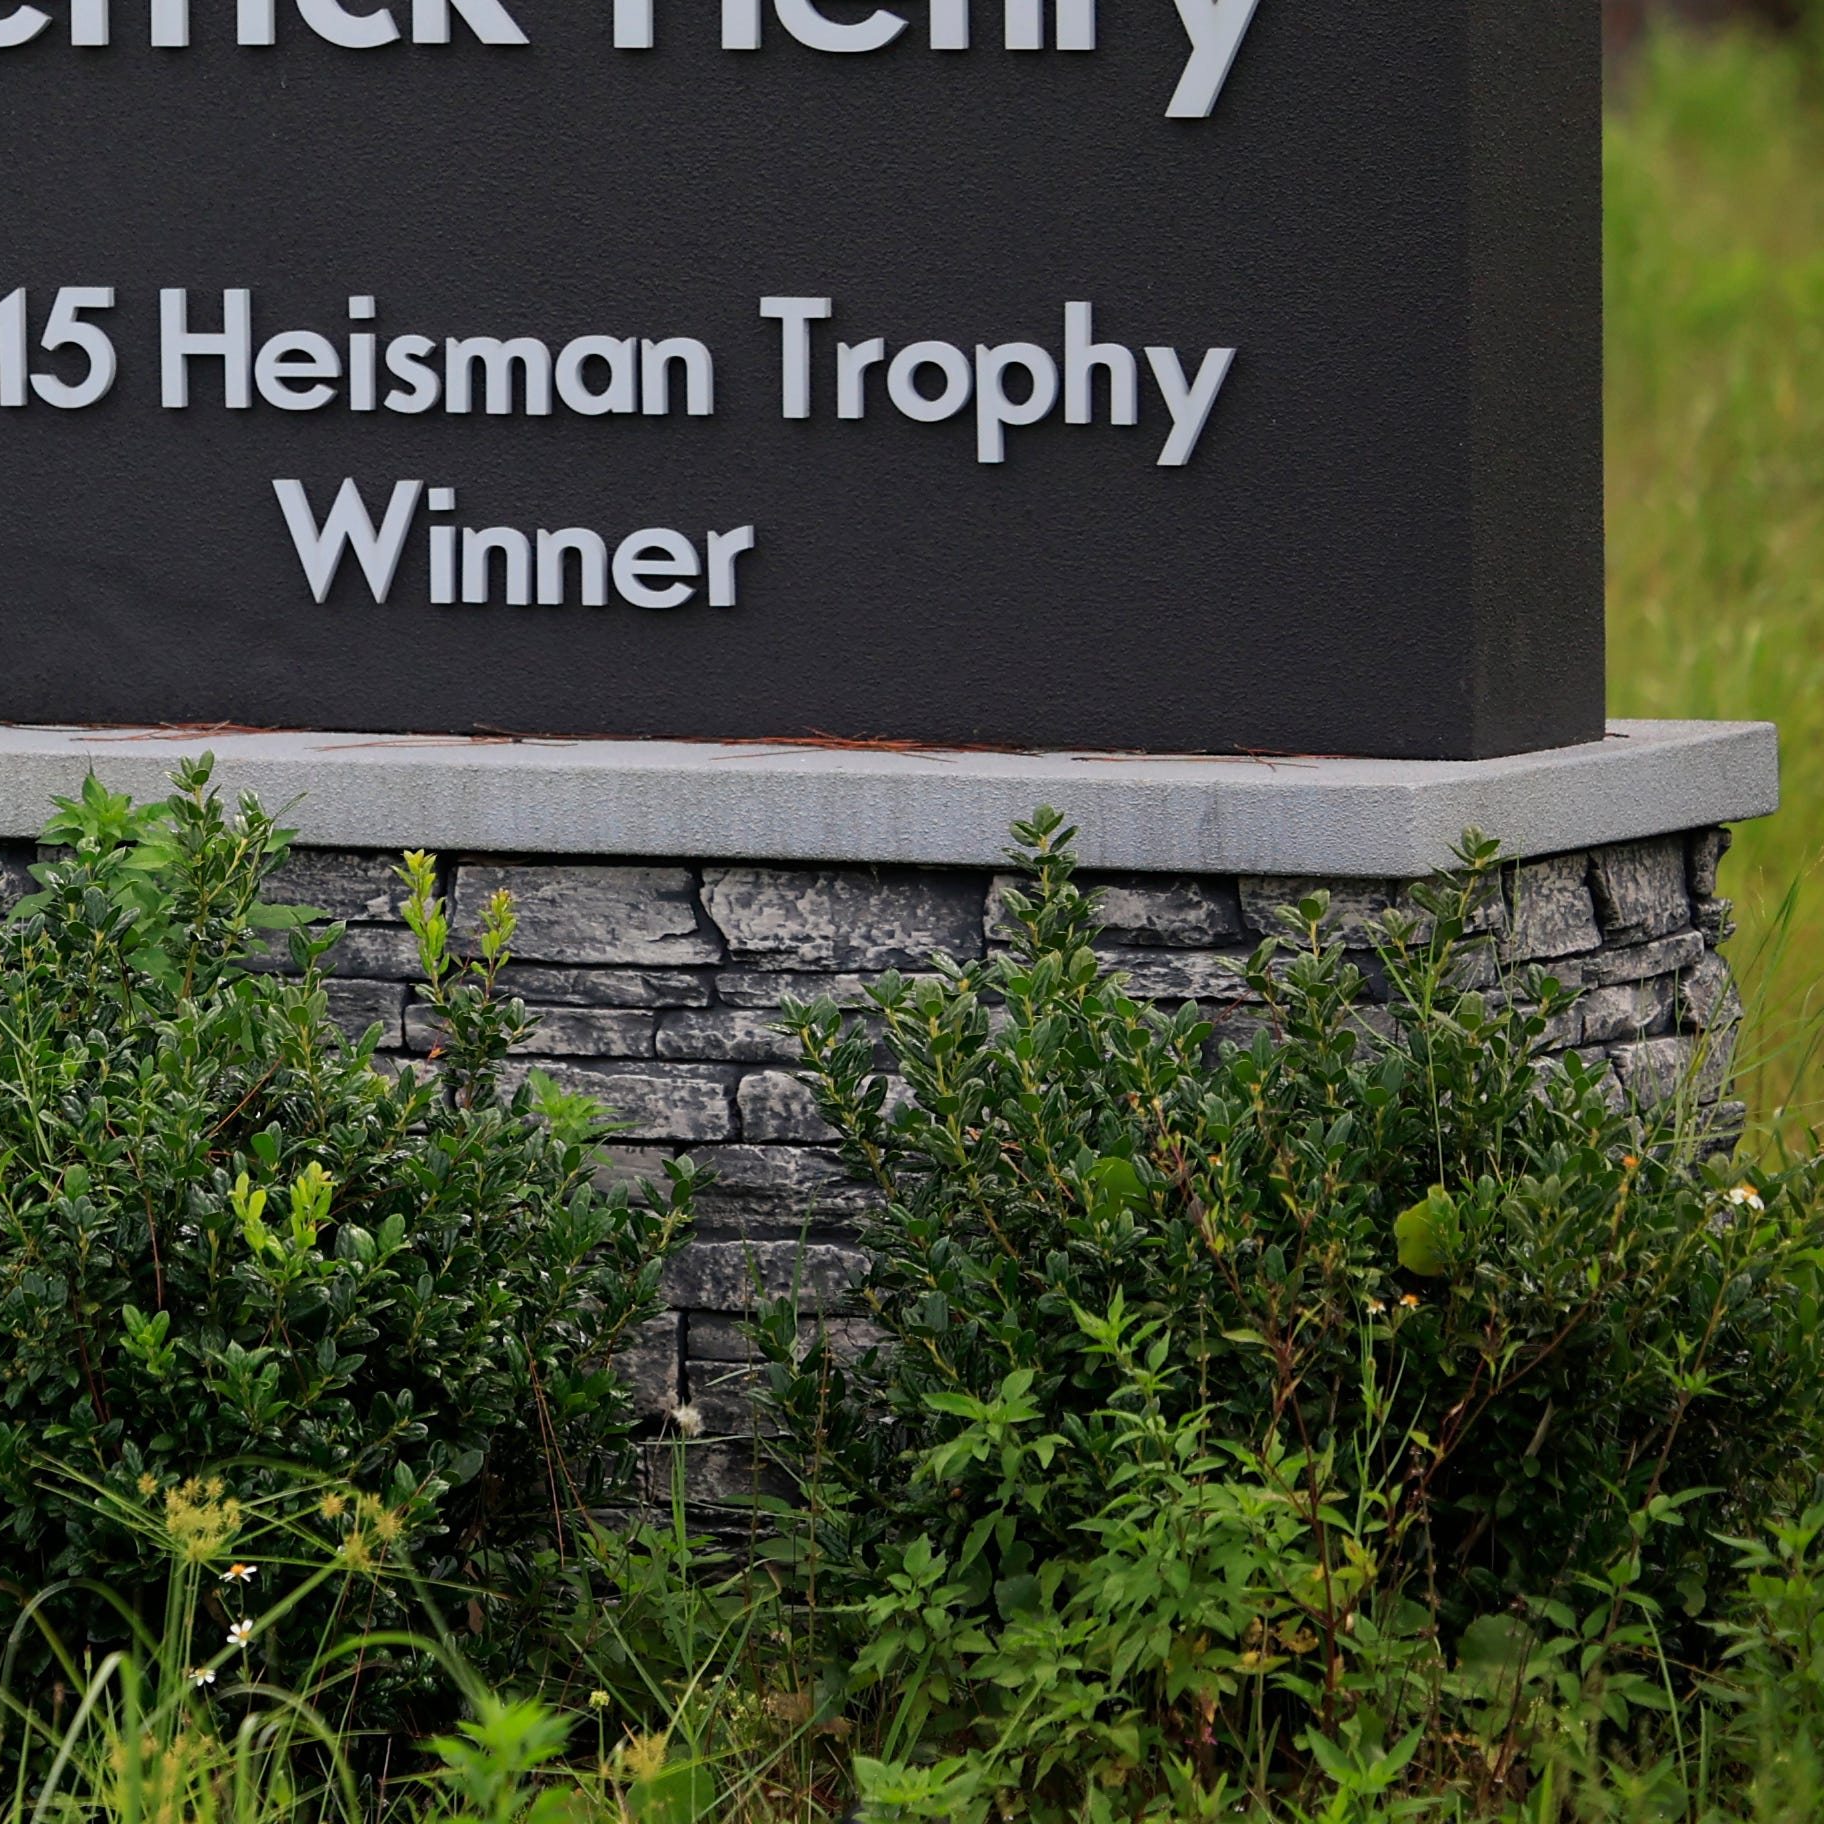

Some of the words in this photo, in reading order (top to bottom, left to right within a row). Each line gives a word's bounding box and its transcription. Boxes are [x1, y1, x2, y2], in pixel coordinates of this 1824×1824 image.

[159, 288, 713, 416] Heisman
[759, 296, 1236, 467] Trophy
[271, 477, 754, 609] Winner
